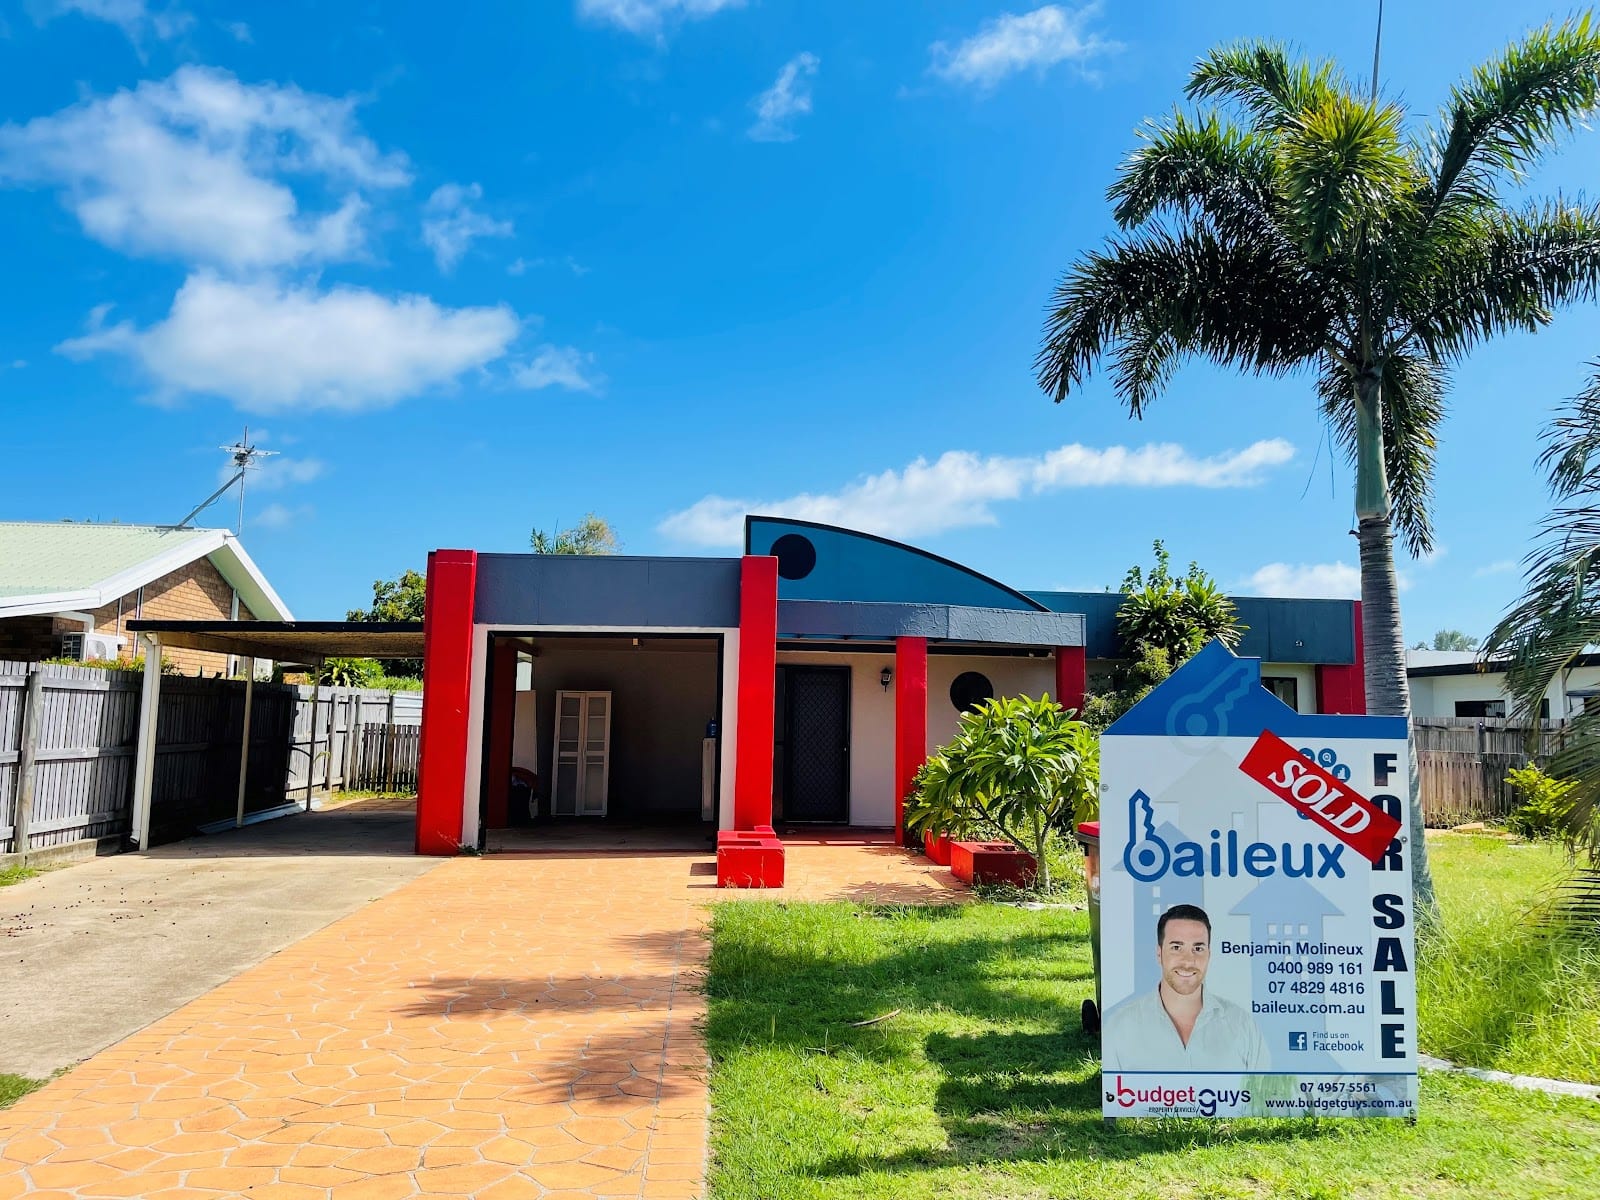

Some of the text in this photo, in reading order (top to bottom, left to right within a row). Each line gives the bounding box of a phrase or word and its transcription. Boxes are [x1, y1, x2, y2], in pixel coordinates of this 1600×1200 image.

[1267, 759, 1371, 834] SOLD
[1123, 788, 1346, 882] baileux
[1221, 941, 1364, 957] Benjamin Molineux
[1268, 961, 1363, 975] 0400 989 161
[1372, 893, 1408, 1059] SALE
[1268, 981, 1365, 995] 07 4829 4816
[1252, 1001, 1365, 1014] baileux.com.au
[1313, 1040, 1364, 1051] Facebook
[1300, 1082, 1376, 1093] 07 4957 5561
[1265, 1098, 1412, 1110] www.budgetguys.com.au
